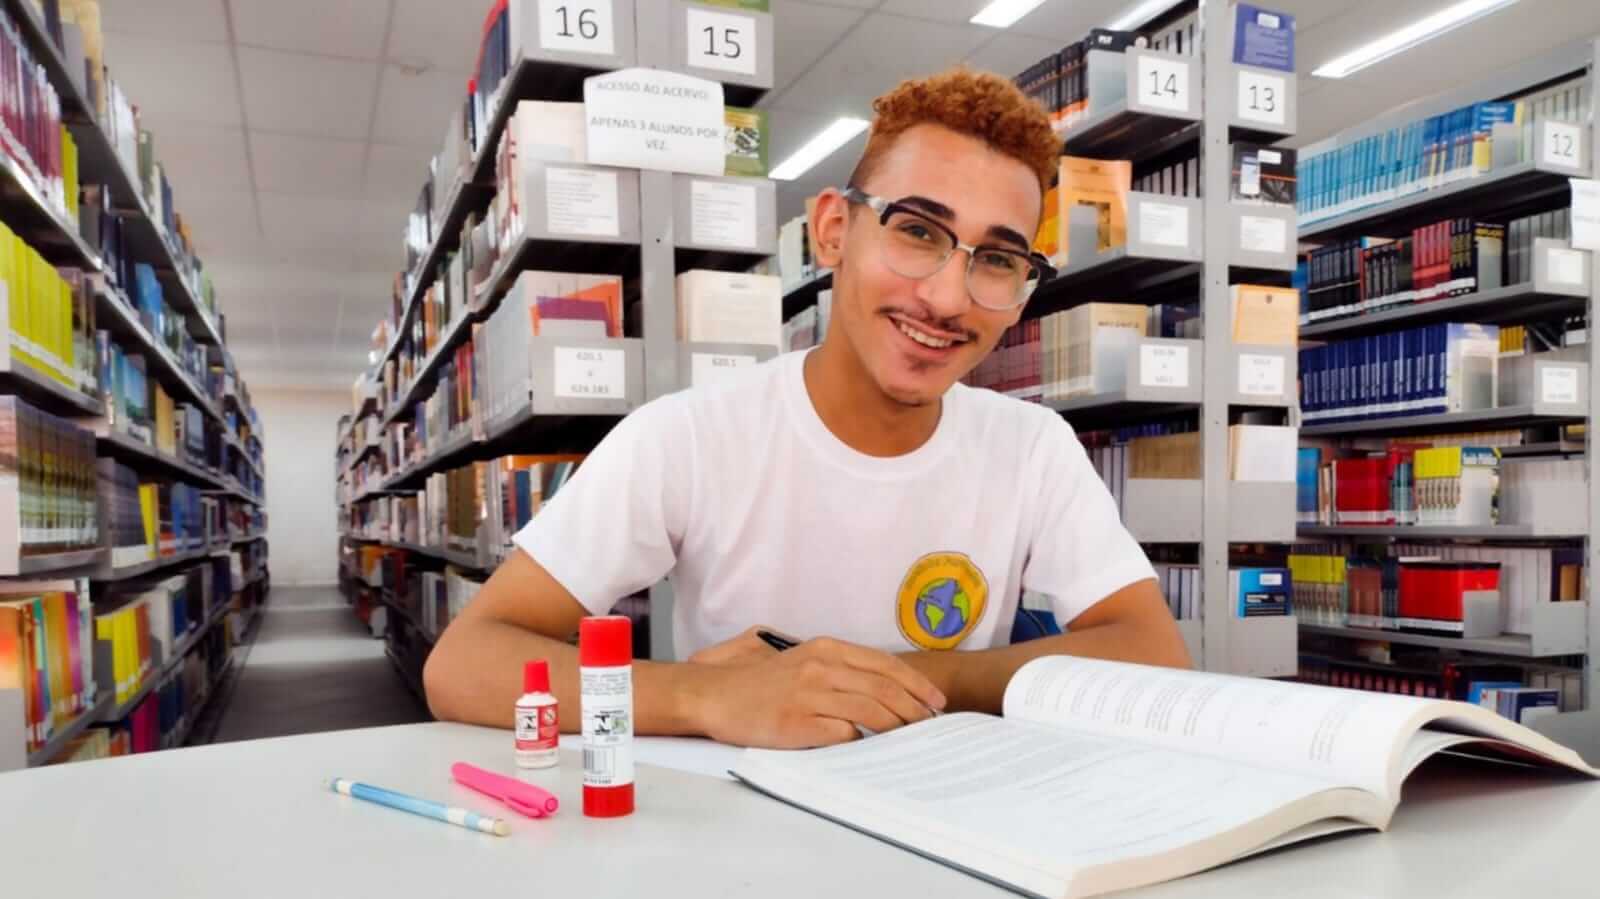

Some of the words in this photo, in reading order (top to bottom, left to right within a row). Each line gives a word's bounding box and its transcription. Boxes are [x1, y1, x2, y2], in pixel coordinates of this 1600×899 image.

[555, 6, 599, 40] 16
[703, 26, 741, 59] 15
[596, 81, 640, 92] ACESSO
[643, 83, 660, 95] AO
[1149, 70, 1179, 98] 14
[1249, 85, 1276, 113] 13
[590, 116, 638, 129] APENAS
[640, 120, 646, 130] 3
[649, 122, 695, 137] ALUNOS
[697, 127, 719, 139] POR
[1551, 132, 1573, 157] 12
